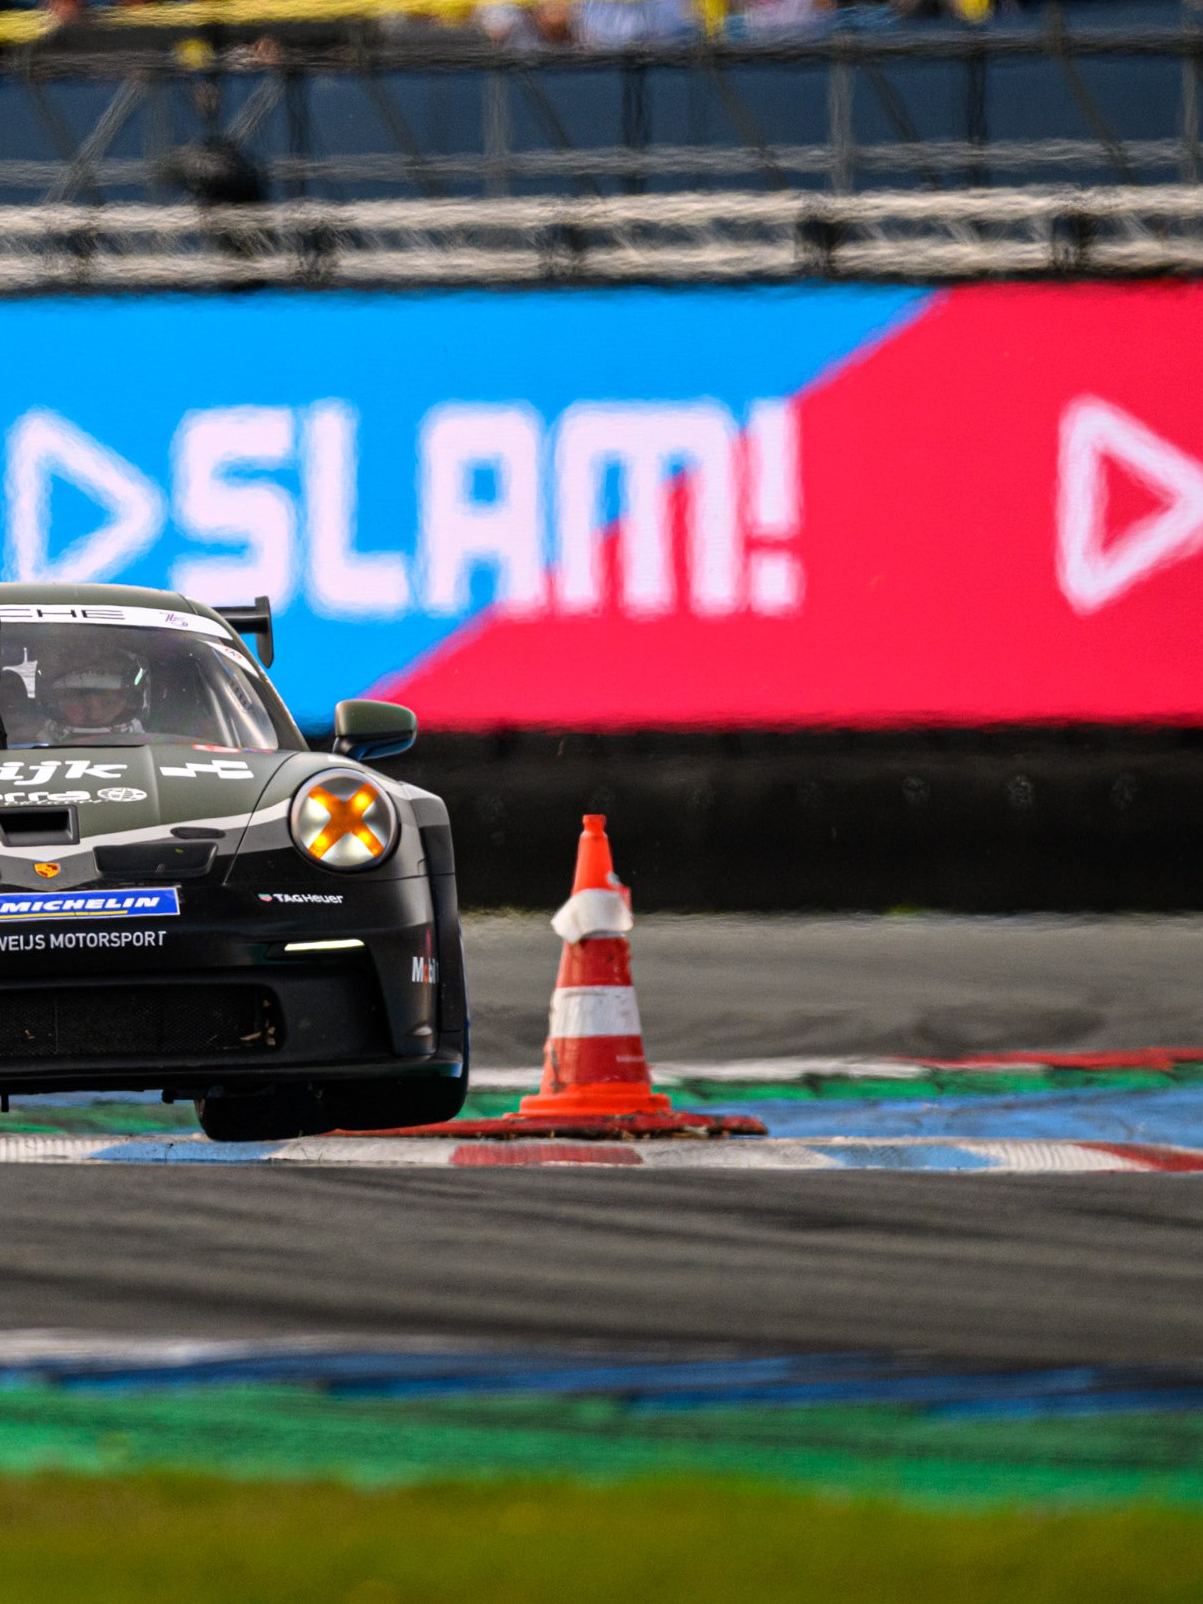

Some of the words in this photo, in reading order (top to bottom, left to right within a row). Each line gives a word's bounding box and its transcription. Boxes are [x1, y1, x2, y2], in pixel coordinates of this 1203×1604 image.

[171, 398, 803, 619] SLAM!
[0, 896, 161, 913] MICHELIN
[50, 930, 167, 949] MOTORSPORT
